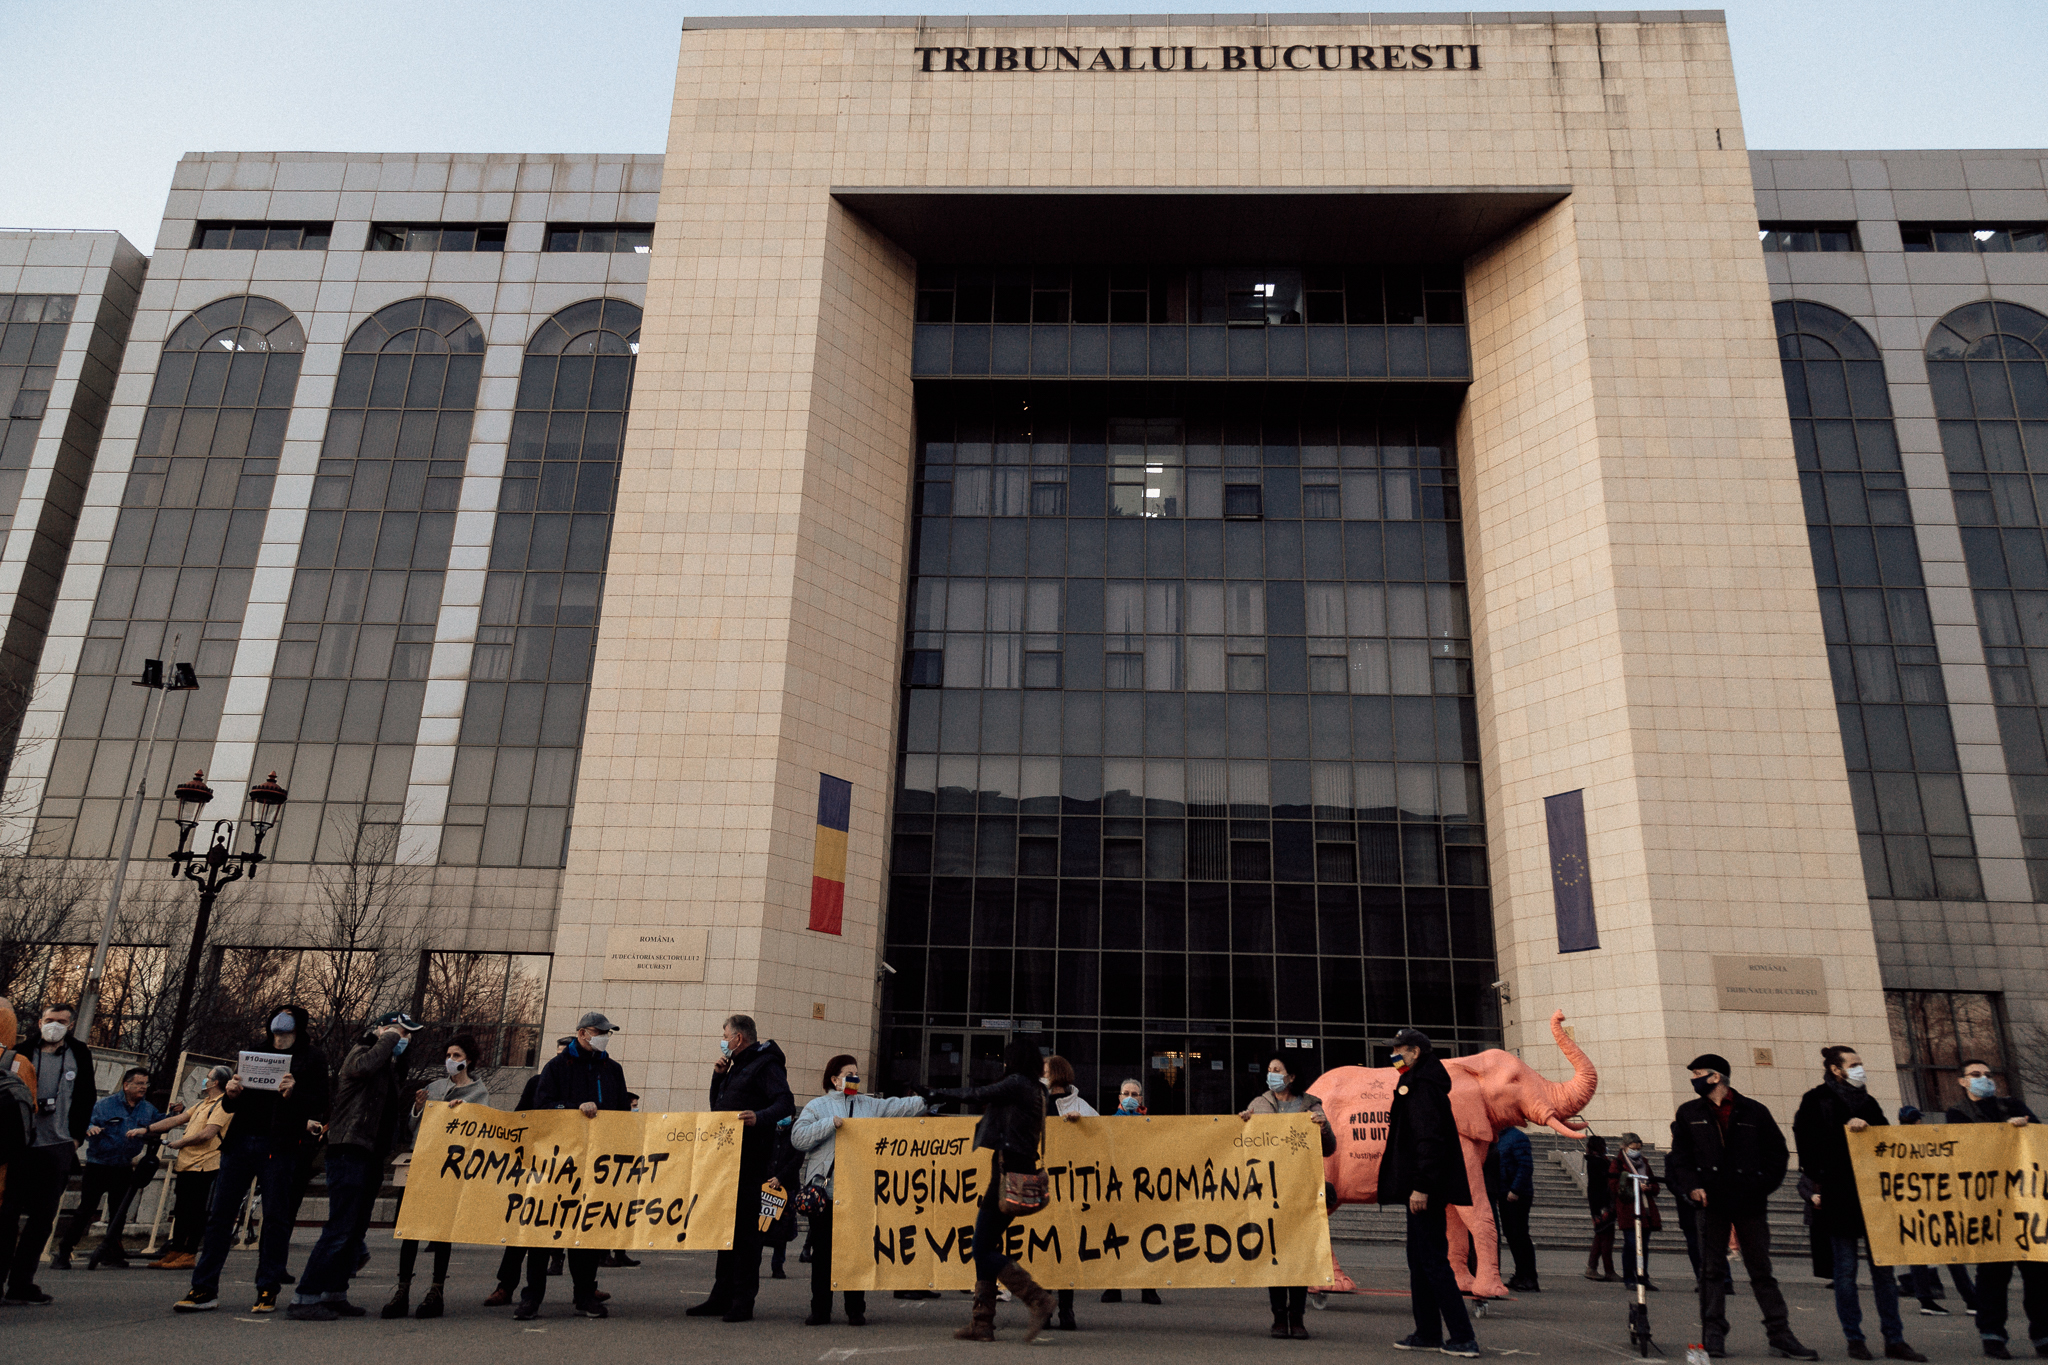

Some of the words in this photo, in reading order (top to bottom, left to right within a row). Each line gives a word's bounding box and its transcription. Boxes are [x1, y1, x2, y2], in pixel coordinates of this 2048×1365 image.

[914, 45, 1207, 72] TRIBUNALUL
[1221, 44, 1482, 71] BUCURESTI
[639, 935, 675, 943] ROMÂNIA
[1726, 986, 1774, 995] TRIBUNALUL
[245, 1055, 286, 1065] #10august
[445, 1118, 478, 1136] #10
[478, 1126, 528, 1143] AUGUST
[666, 1128, 709, 1143] declic
[1233, 1132, 1280, 1148] declic
[1352, 1127, 1367, 1141] NU
[1370, 1125, 1390, 1141] UIT
[875, 1138, 907, 1157] #10
[910, 1137, 969, 1157] AUGUST
[1875, 1141, 1907, 1159] #10
[1910, 1141, 1959, 1160] AUGUST
[594, 1152, 669, 1187] STAT
[1048, 1160, 1123, 1212] TIȚIA
[1879, 1171, 1952, 1202] PESTE
[1957, 1170, 1999, 1201] TOT
[873, 1223, 916, 1265] NE
[924, 1224, 1062, 1265] VEEM
[1078, 1222, 1129, 1262] LA
[1140, 1218, 1278, 1265] CEDO!
